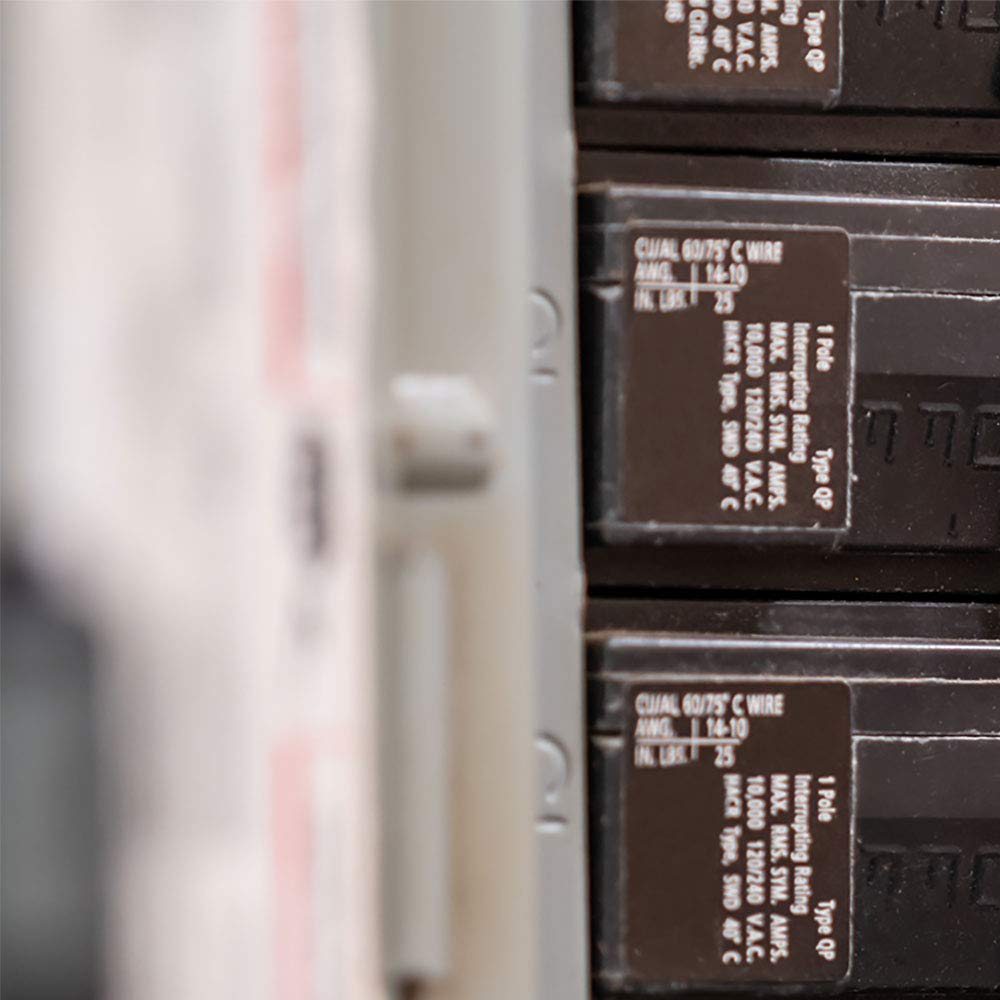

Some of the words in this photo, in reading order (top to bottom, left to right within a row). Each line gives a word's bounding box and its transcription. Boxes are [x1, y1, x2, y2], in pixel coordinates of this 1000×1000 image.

[737, 21, 755, 72] V.A.C.
[760, 22, 778, 72] AMPS.
[804, 10, 826, 46] Type
[713, 58, 732, 72] C
[805, 49, 826, 72] QP
[731, 240, 744, 262] C
[747, 241, 783, 263] WIRE
[715, 291, 735, 313] 25
[722, 320, 740, 364] HACR
[817, 324, 834, 333] 1
[744, 322, 764, 377] 10,000
[789, 322, 810, 410] Interrupting
[816, 338, 834, 371] Pole
[770, 372, 786, 410] RMS.
[744, 387, 764, 452] 120/240
[768, 414, 786, 452] SYM.
[788, 414, 810, 464] Rating
[744, 460, 762, 510] V.A.C.
[812, 448, 834, 484] Type
[720, 497, 738, 510] C
[768, 461, 785, 510] AMPS.
[814, 487, 833, 510] QP
[732, 693, 744, 716] C
[747, 694, 784, 715] WIRE
[715, 746, 736, 767] 25
[724, 774, 740, 818] HACR
[818, 776, 836, 784] 1
[746, 775, 764, 830] 10,000
[791, 774, 812, 862] Interrupting
[817, 790, 836, 822] Pole
[770, 824, 788, 862] RMS.
[746, 840, 764, 904] 120/240
[770, 866, 788, 905] SYM.
[790, 866, 811, 914] Rating
[814, 900, 836, 934] Type
[746, 914, 764, 962] V.A.C.
[770, 914, 787, 963] AMPS.
[815, 938, 834, 960] QP
[722, 951, 739, 964] C
